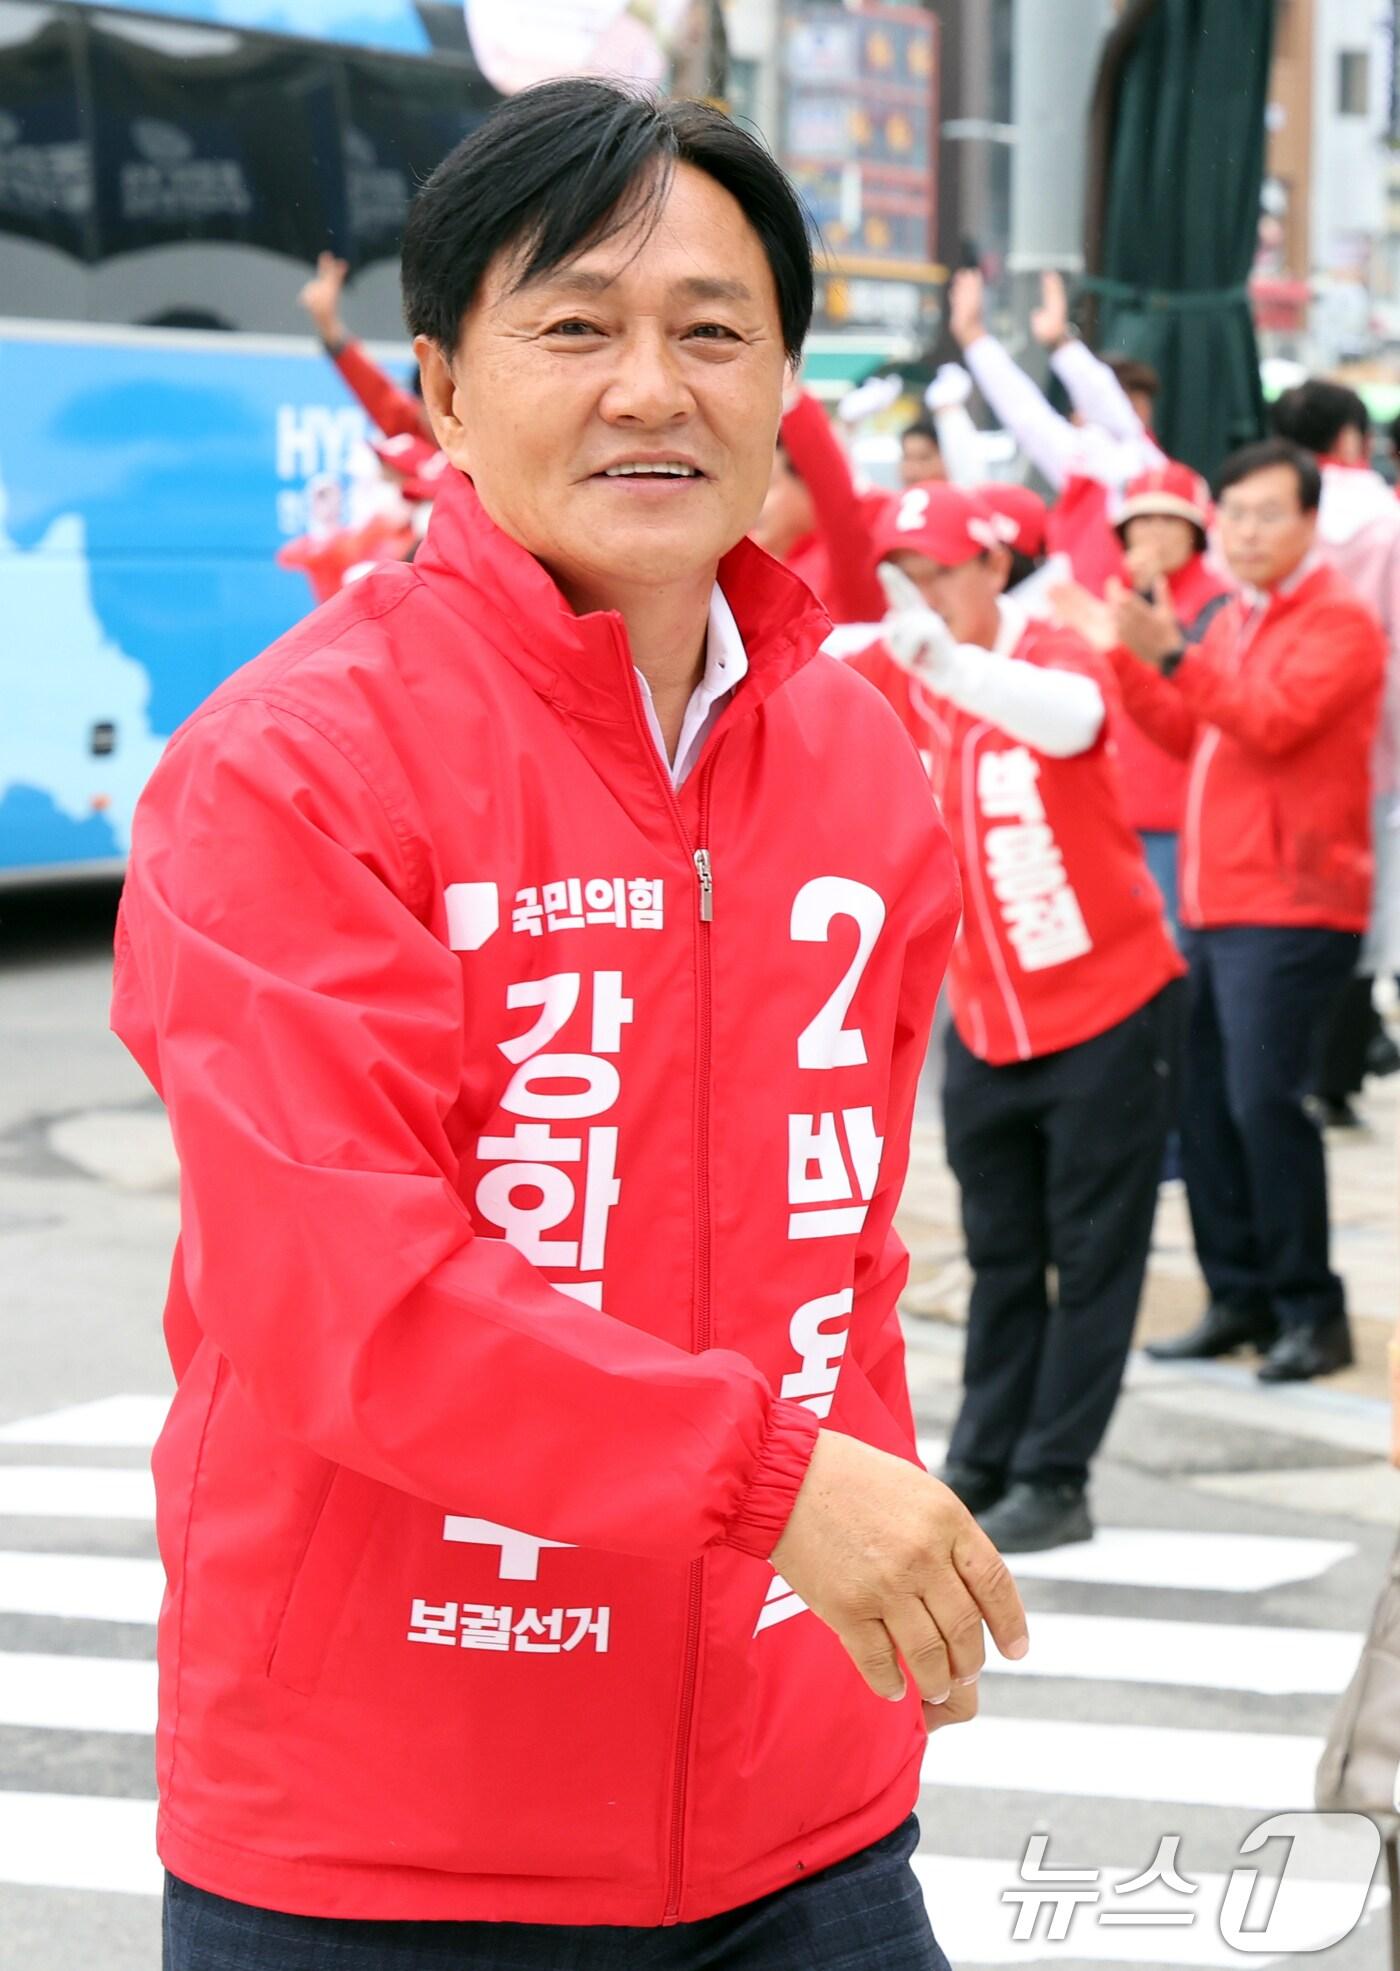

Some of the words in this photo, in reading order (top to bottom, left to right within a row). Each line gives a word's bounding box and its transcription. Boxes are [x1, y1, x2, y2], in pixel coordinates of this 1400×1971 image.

[897, 488, 929, 531] 2
[513, 878, 663, 936] 국민의힘
[790, 876, 886, 1069] 2
[408, 1599, 609, 1652] 보궐선거
